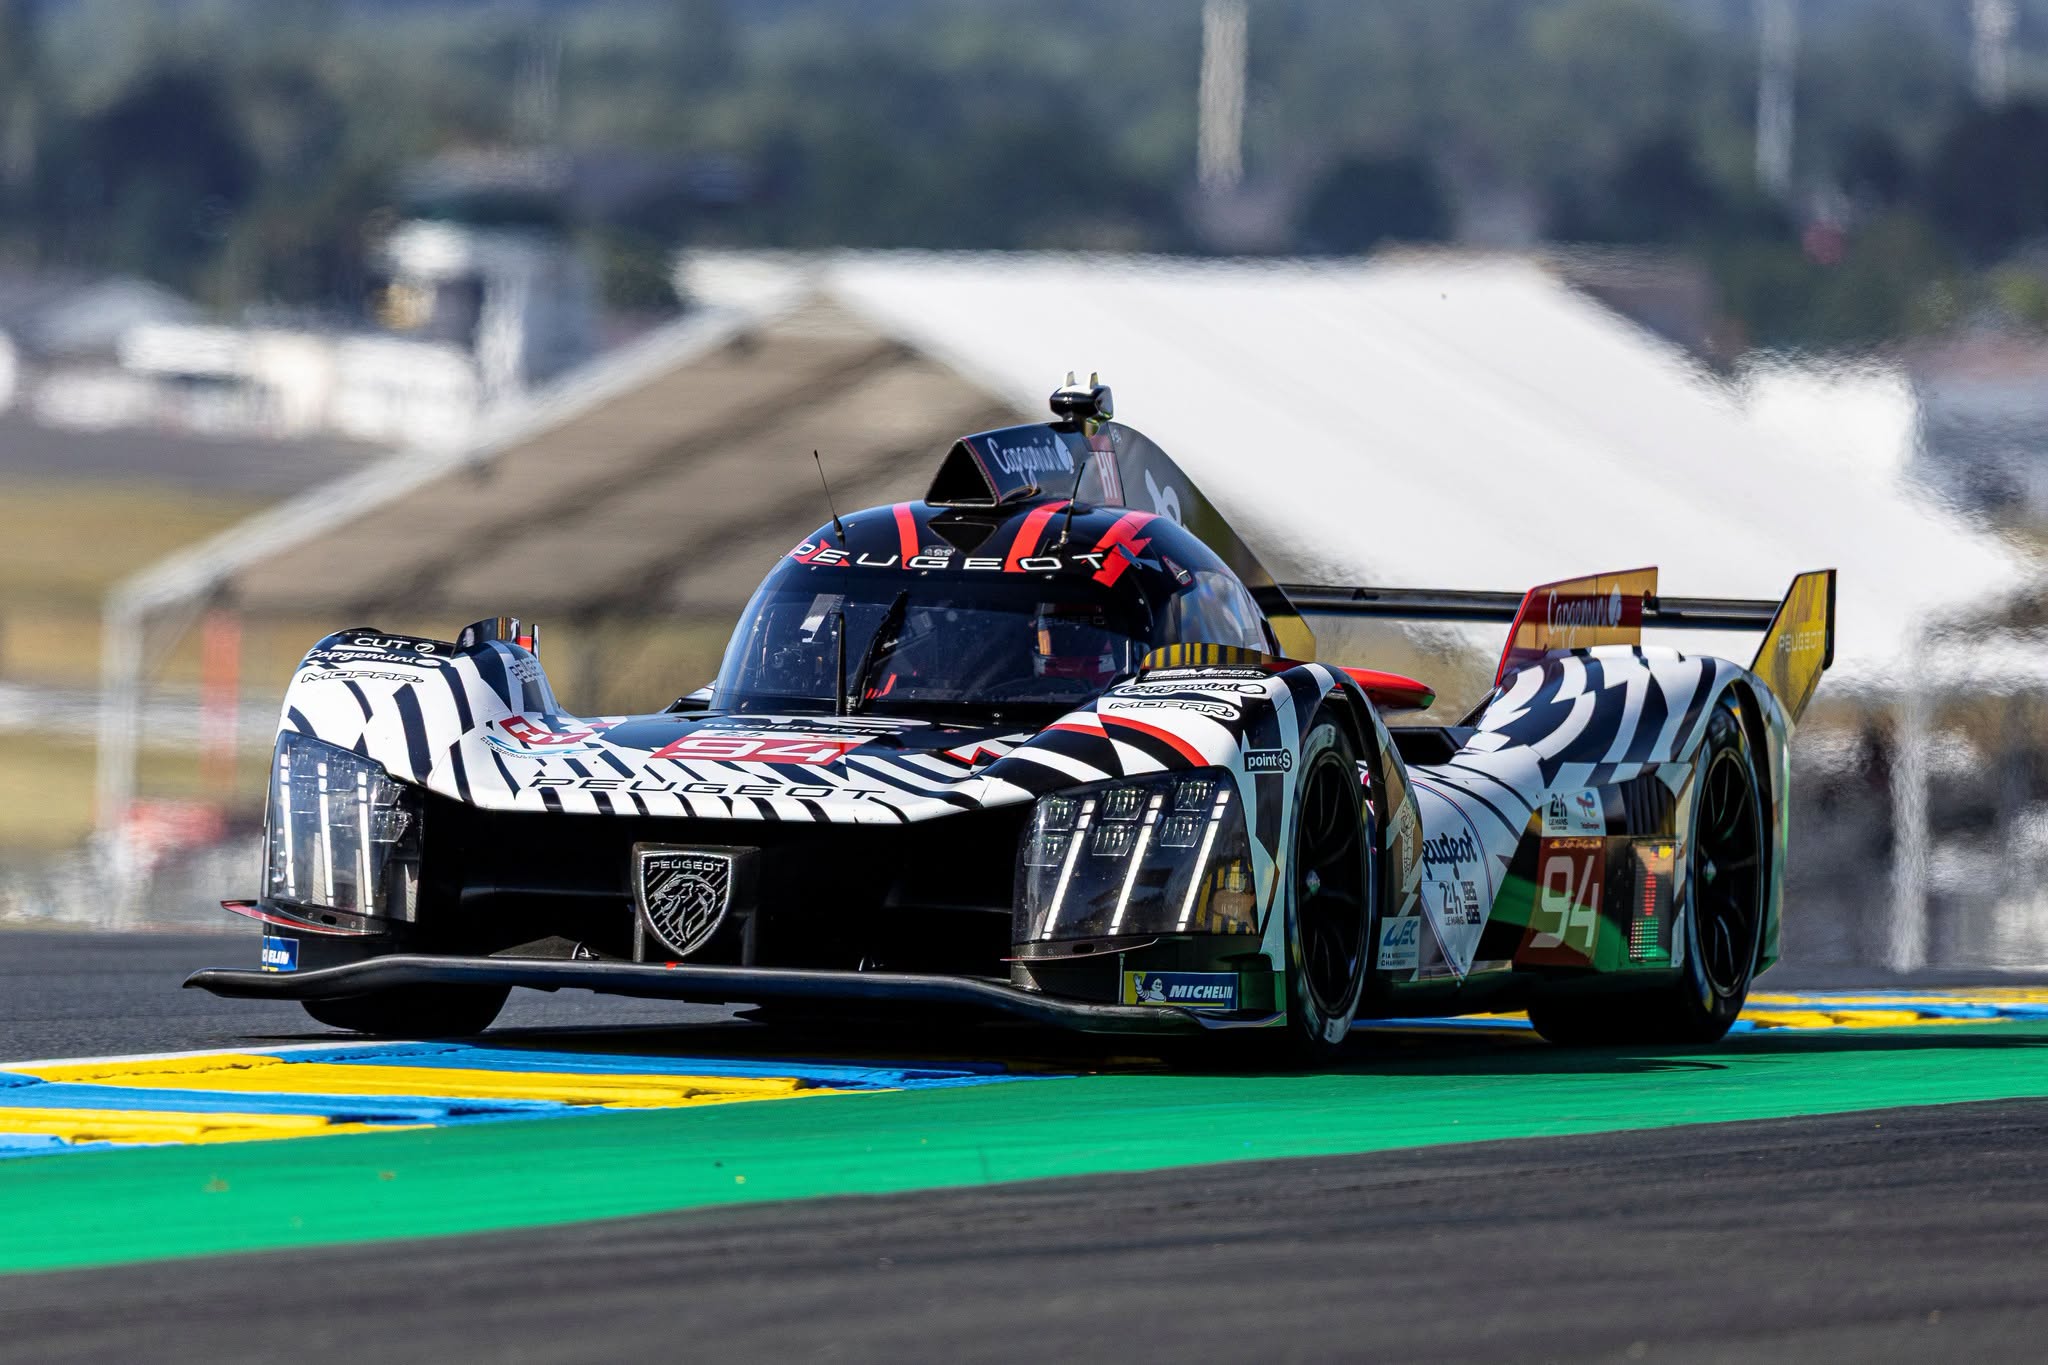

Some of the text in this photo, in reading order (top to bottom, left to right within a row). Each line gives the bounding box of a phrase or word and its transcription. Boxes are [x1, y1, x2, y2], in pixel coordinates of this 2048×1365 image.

[792, 543, 1103, 571] PEUGEOT
[353, 637, 411, 650] CUT
[1778, 631, 1823, 652] PEUGEOT
[302, 649, 417, 663] Capgemini
[301, 671, 424, 683] MOPAR
[1120, 682, 1238, 694] Capgemini
[1108, 702, 1234, 717] MOPAR
[702, 723, 903, 735] TotalEnergies
[667, 739, 842, 762] 94
[1248, 752, 1291, 770] point S
[528, 778, 886, 801] PEUGEOT
[650, 861, 725, 872] PEUGEOT
[1529, 855, 1600, 948] 94
[1383, 919, 1419, 947] WEC
[1169, 984, 1234, 999] MICHELIN
